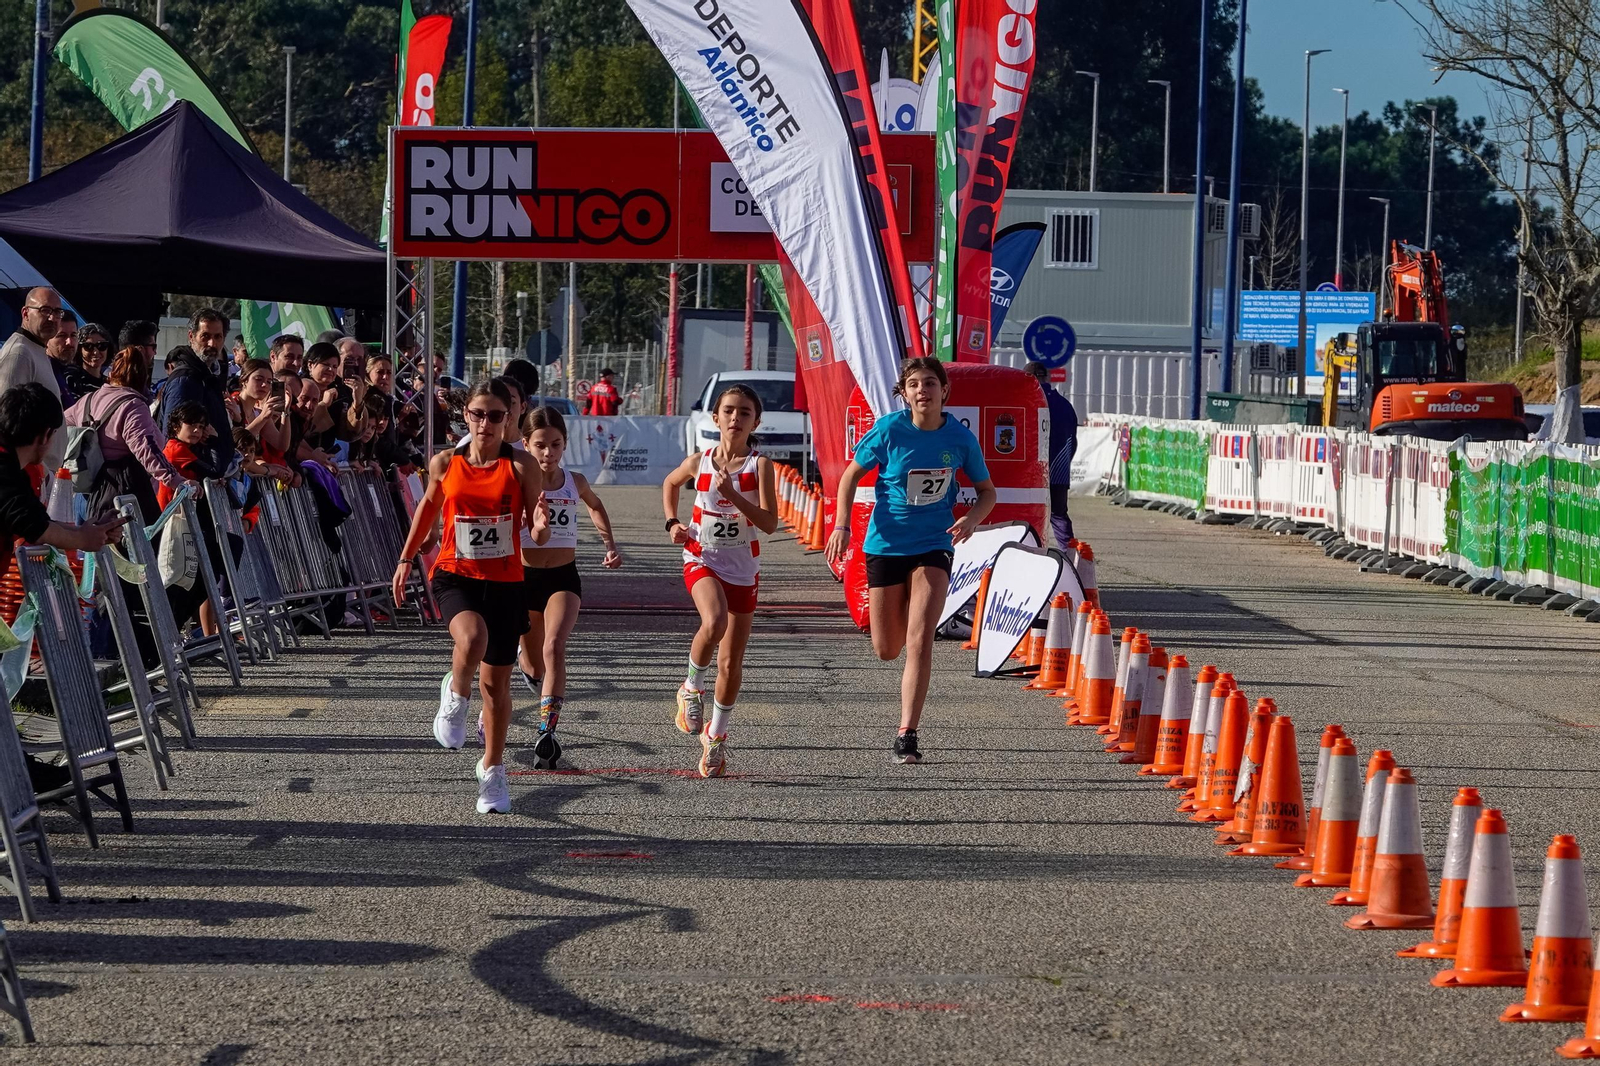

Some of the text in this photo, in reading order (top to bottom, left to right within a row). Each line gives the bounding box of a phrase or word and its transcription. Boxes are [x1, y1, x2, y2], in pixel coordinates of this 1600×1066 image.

[697, 46, 774, 153] Atlántico
[410, 146, 533, 190] RUN
[1427, 401, 1480, 413] mateco
[608, 455, 640, 465] Galega
[608, 463, 648, 471] Atletismo
[921, 478, 946, 494] 27
[548, 508, 570, 526] 26
[469, 527, 500, 546] 24
[713, 522, 740, 538] 25
[983, 588, 1035, 638] Atlántico
